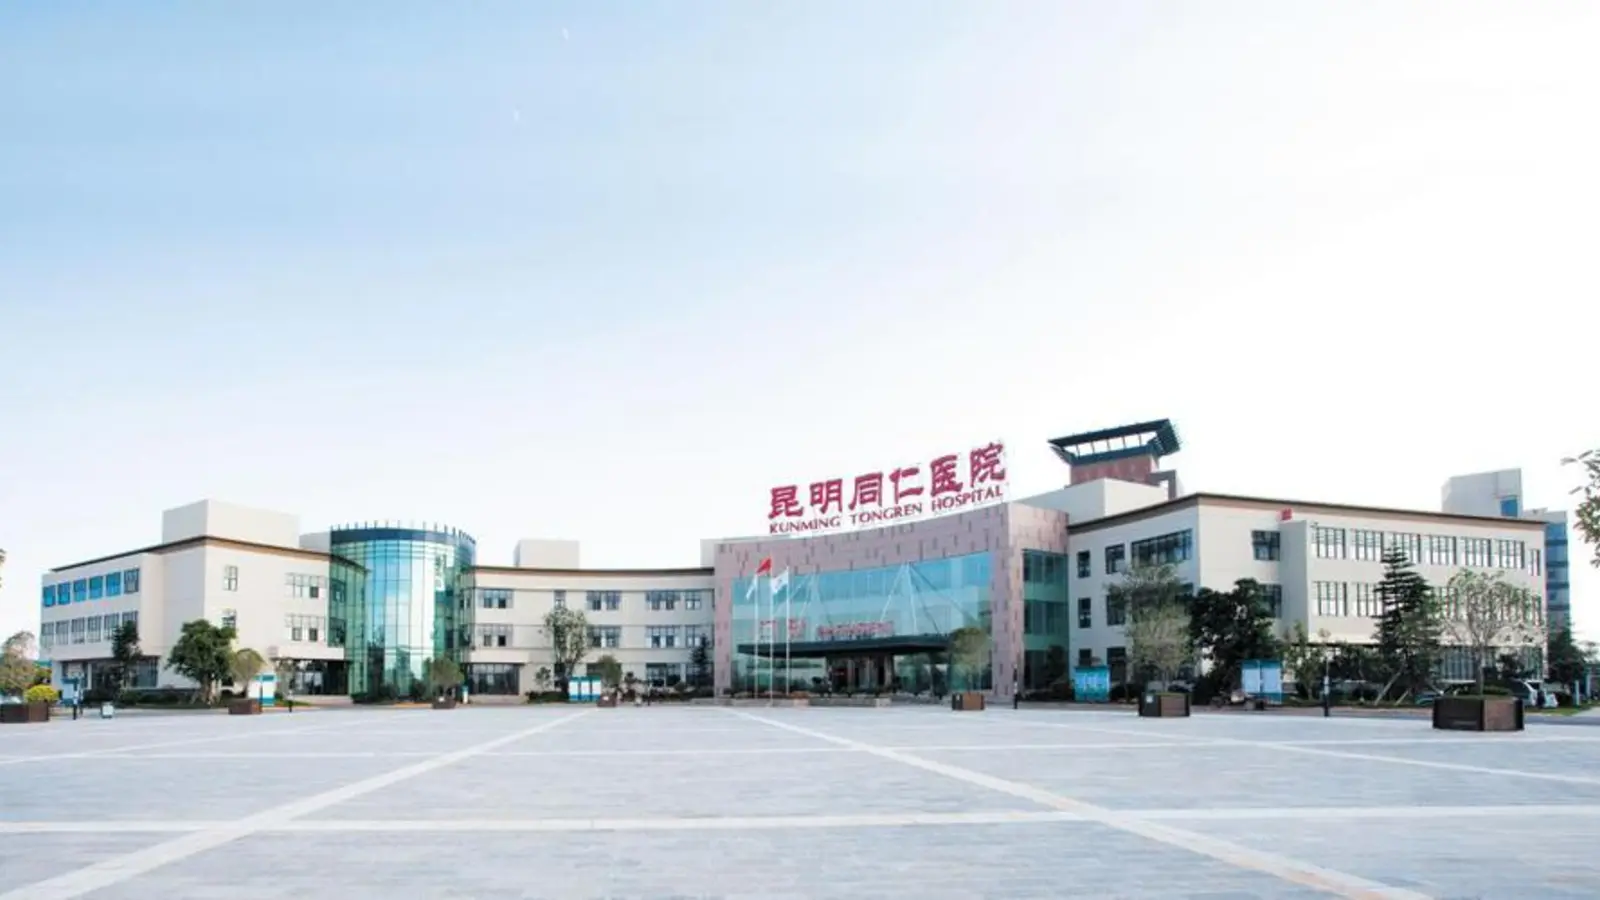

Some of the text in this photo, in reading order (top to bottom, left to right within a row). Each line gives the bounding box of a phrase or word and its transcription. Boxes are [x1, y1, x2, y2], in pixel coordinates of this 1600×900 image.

[768, 442, 1006, 519] 昆明同仁医院
[769, 485, 1003, 534] KUNMING TONGREN HOSPITAL
